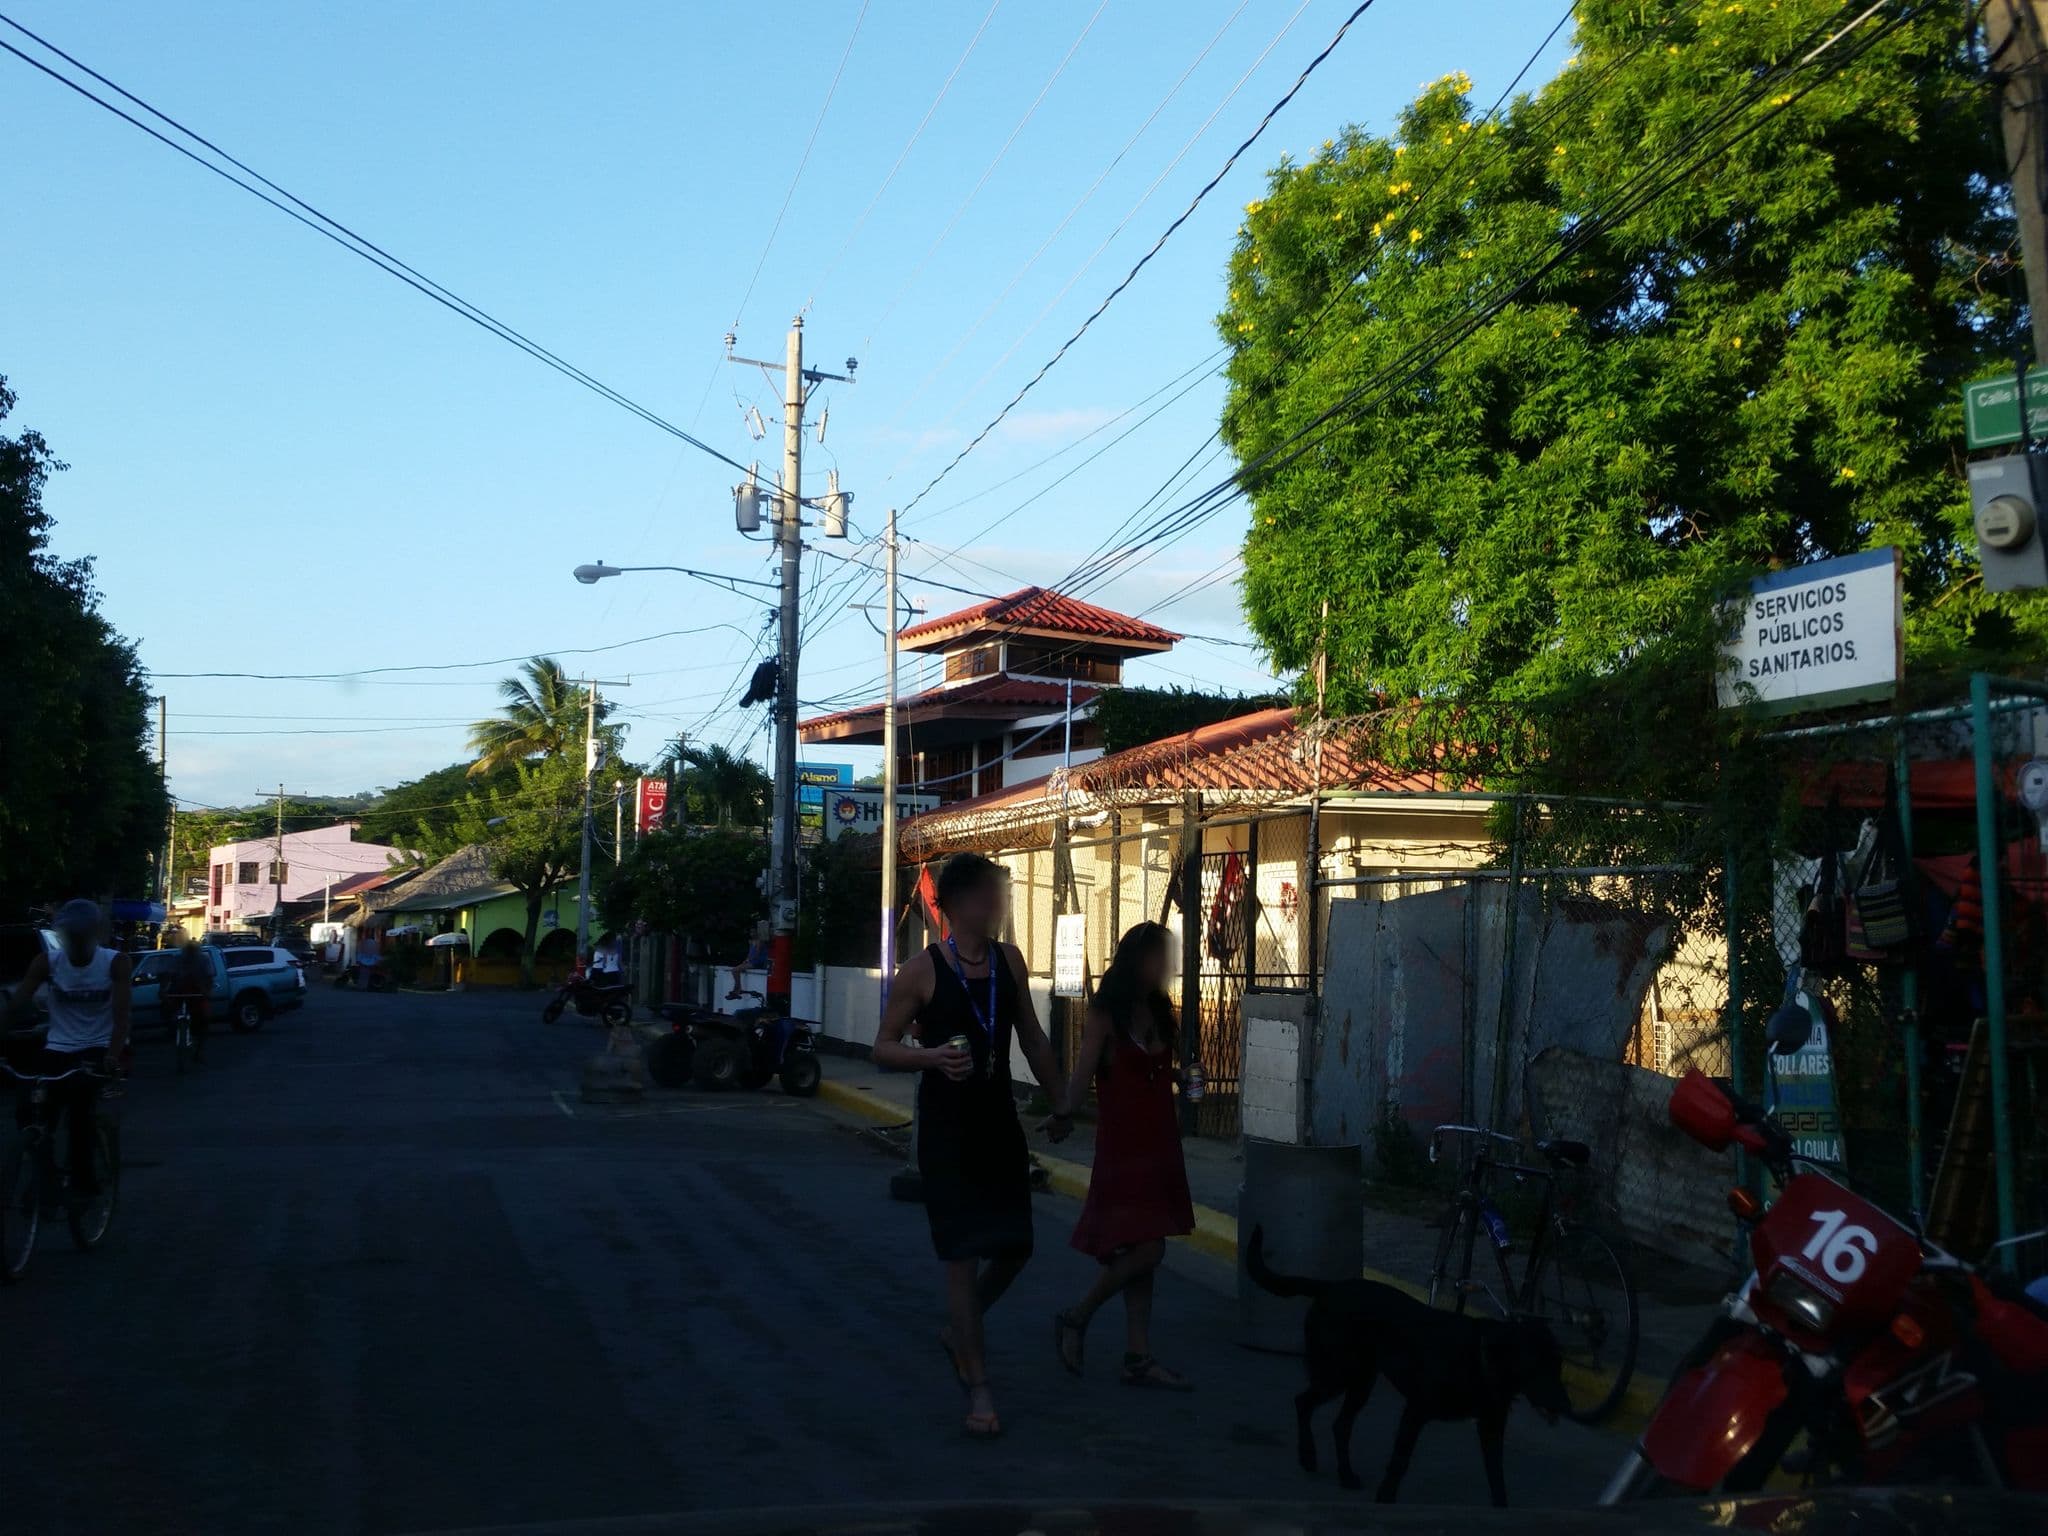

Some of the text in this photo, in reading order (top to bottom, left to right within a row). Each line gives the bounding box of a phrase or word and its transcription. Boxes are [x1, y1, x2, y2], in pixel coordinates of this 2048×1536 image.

[1978, 389, 2011, 407] Calle
[1755, 582, 1846, 620] SERVICIOS
[1758, 612, 1843, 647] PÚBLICOS
[648, 781, 667, 790] ATM
[800, 770, 837, 782] Alamo
[863, 801, 931, 821] HTE
[1801, 1209, 1878, 1284] 16
